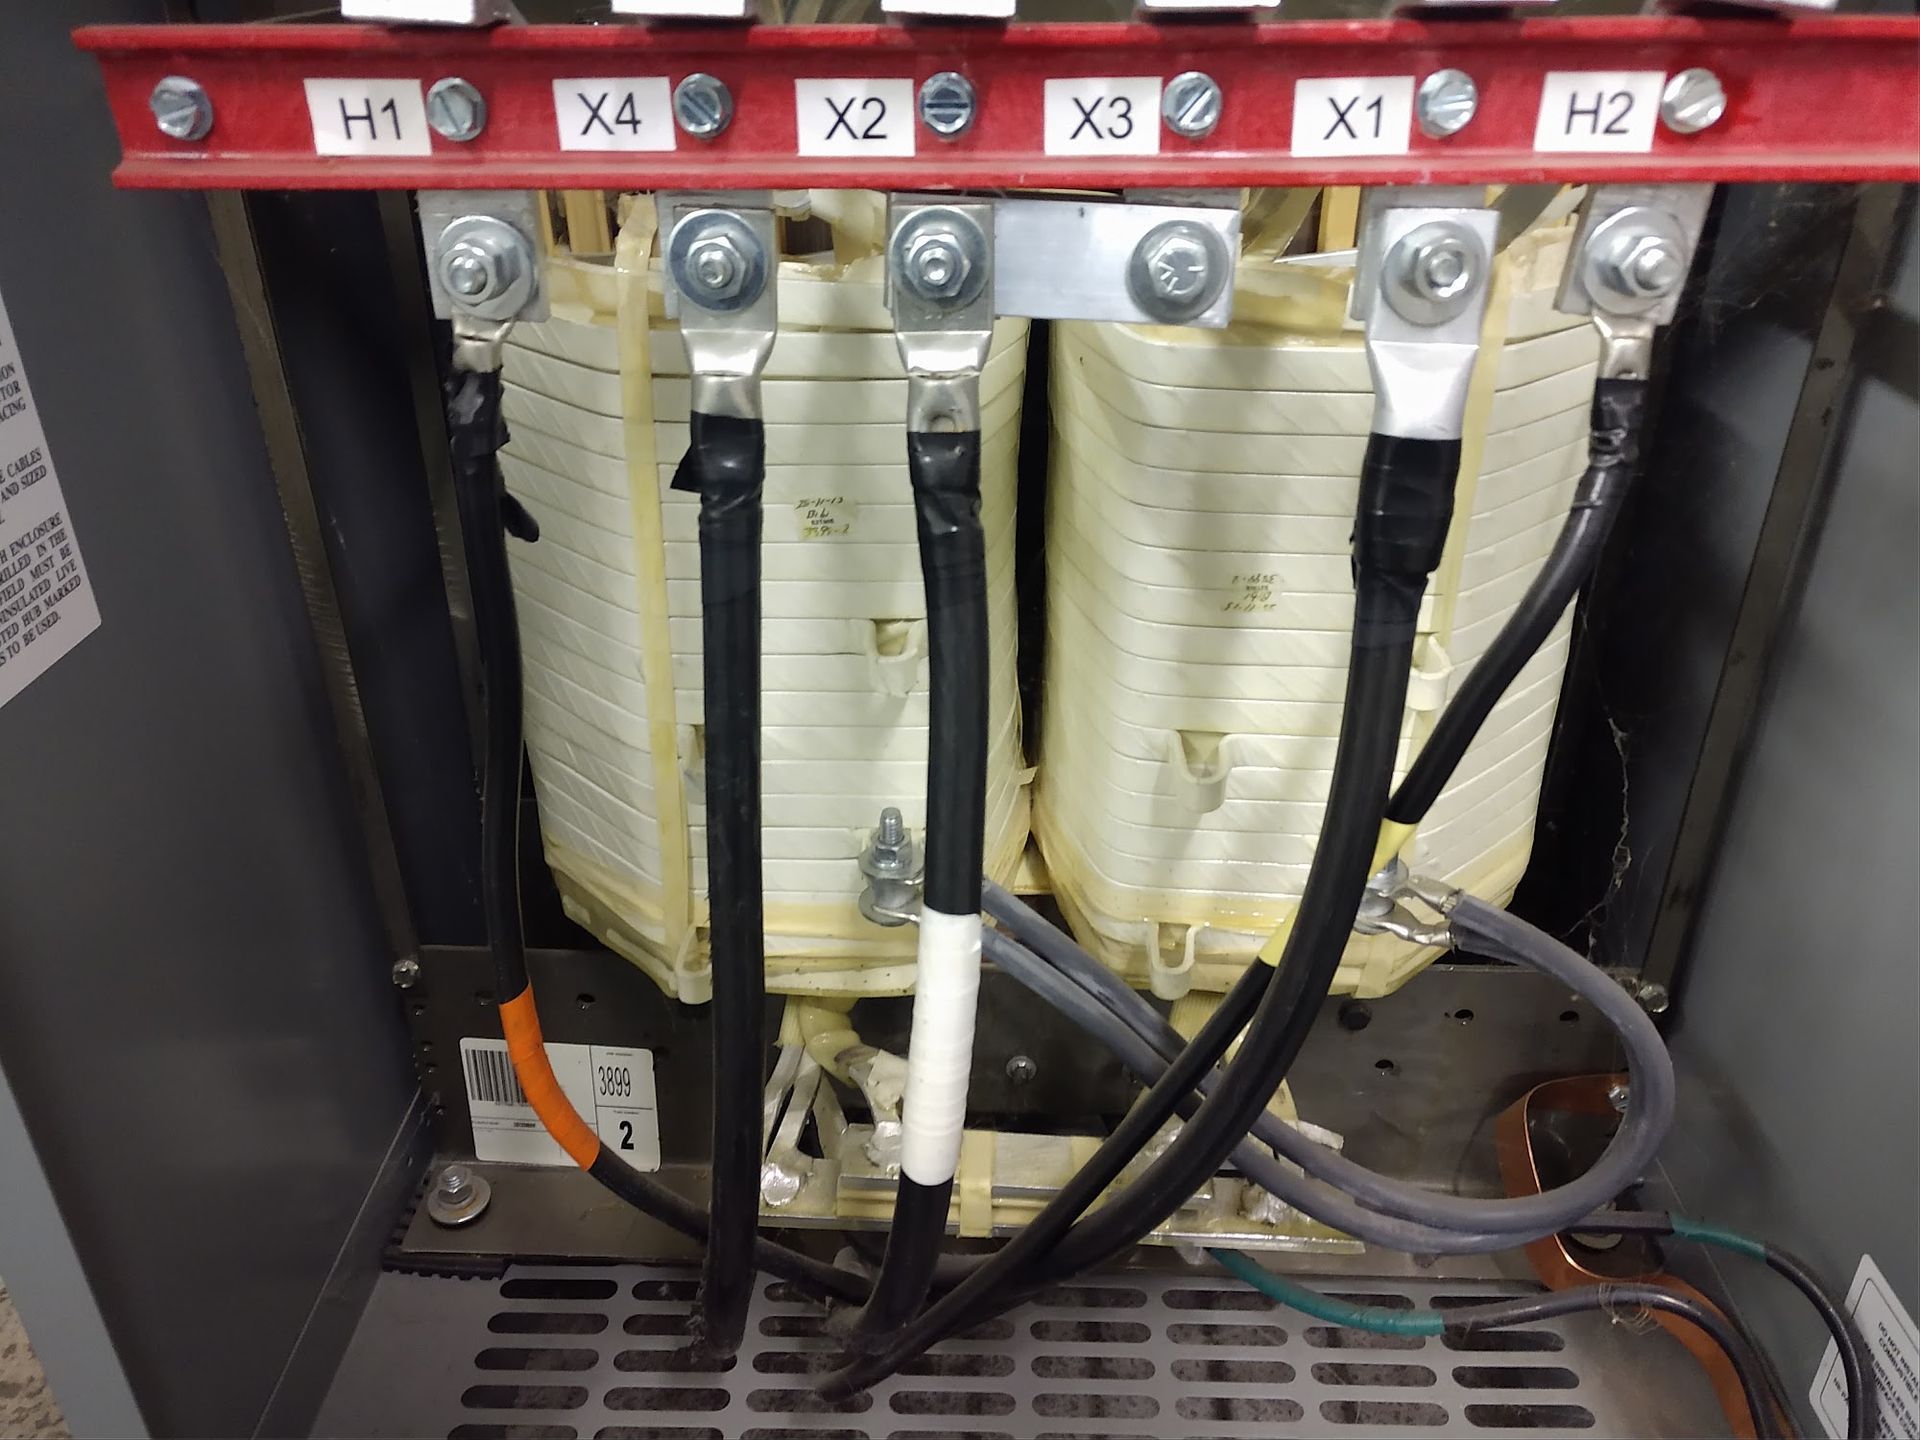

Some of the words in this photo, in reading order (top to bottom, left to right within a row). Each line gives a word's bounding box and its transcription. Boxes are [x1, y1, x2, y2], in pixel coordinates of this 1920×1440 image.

[340, 98, 402, 140] H1
[578, 92, 641, 135] X4
[825, 97, 888, 140] X2
[1071, 97, 1133, 139] X3
[1325, 96, 1384, 139] X1
[1565, 91, 1630, 135] H2
[7, 447, 42, 478] CABLES
[0, 482, 19, 503] AND
[20, 464, 47, 490] SIZED
[9, 512, 63, 557] ENCLOSURE
[48, 528, 68, 549] THE
[30, 555, 54, 580] MUST
[59, 542, 72, 560] BE
[56, 559, 77, 582] LIVE
[21, 604, 42, 627] HUB
[43, 574, 81, 610] MARKED
[6, 641, 20, 659] TO
[22, 628, 36, 647] BE
[597, 1065, 631, 1097] 3899
[619, 1120, 635, 1150] 2
